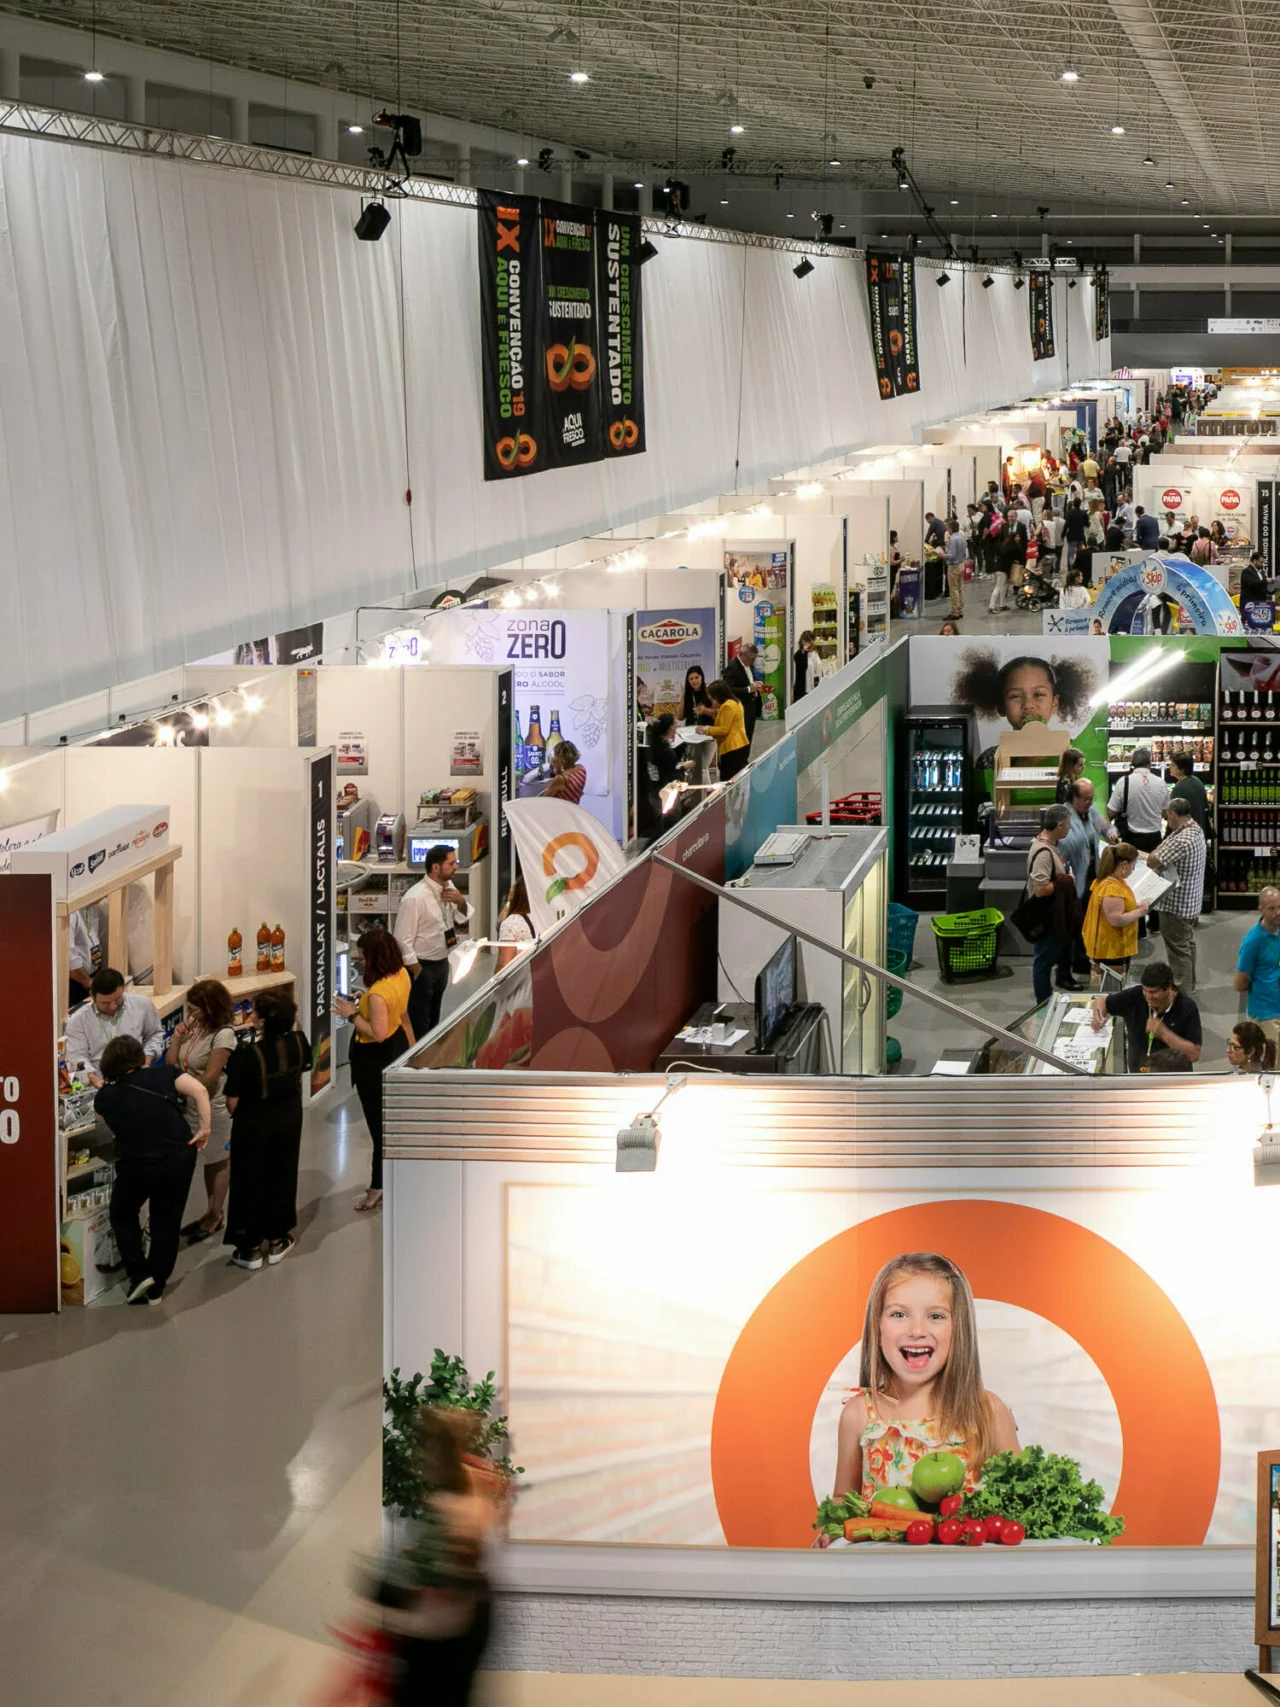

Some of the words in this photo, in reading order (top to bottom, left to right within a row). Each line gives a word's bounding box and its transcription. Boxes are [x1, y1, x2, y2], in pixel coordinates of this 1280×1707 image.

[496, 206, 520, 253] IX
[620, 226, 630, 256] UM
[496, 257, 509, 308] AQUI
[607, 223, 622, 405] SUSTENTADO
[498, 331, 512, 419] FRESCO
[563, 428, 584, 444] FRESCO
[564, 413, 583, 429] AQUI
[1163, 495, 1181, 503] PAIVA
[1146, 571, 1164, 585] Skip
[507, 620, 550, 631] zona
[317, 781, 324, 798] 1
[316, 818, 326, 903] LACTALIS
[316, 923, 325, 1017] PARMALAT
